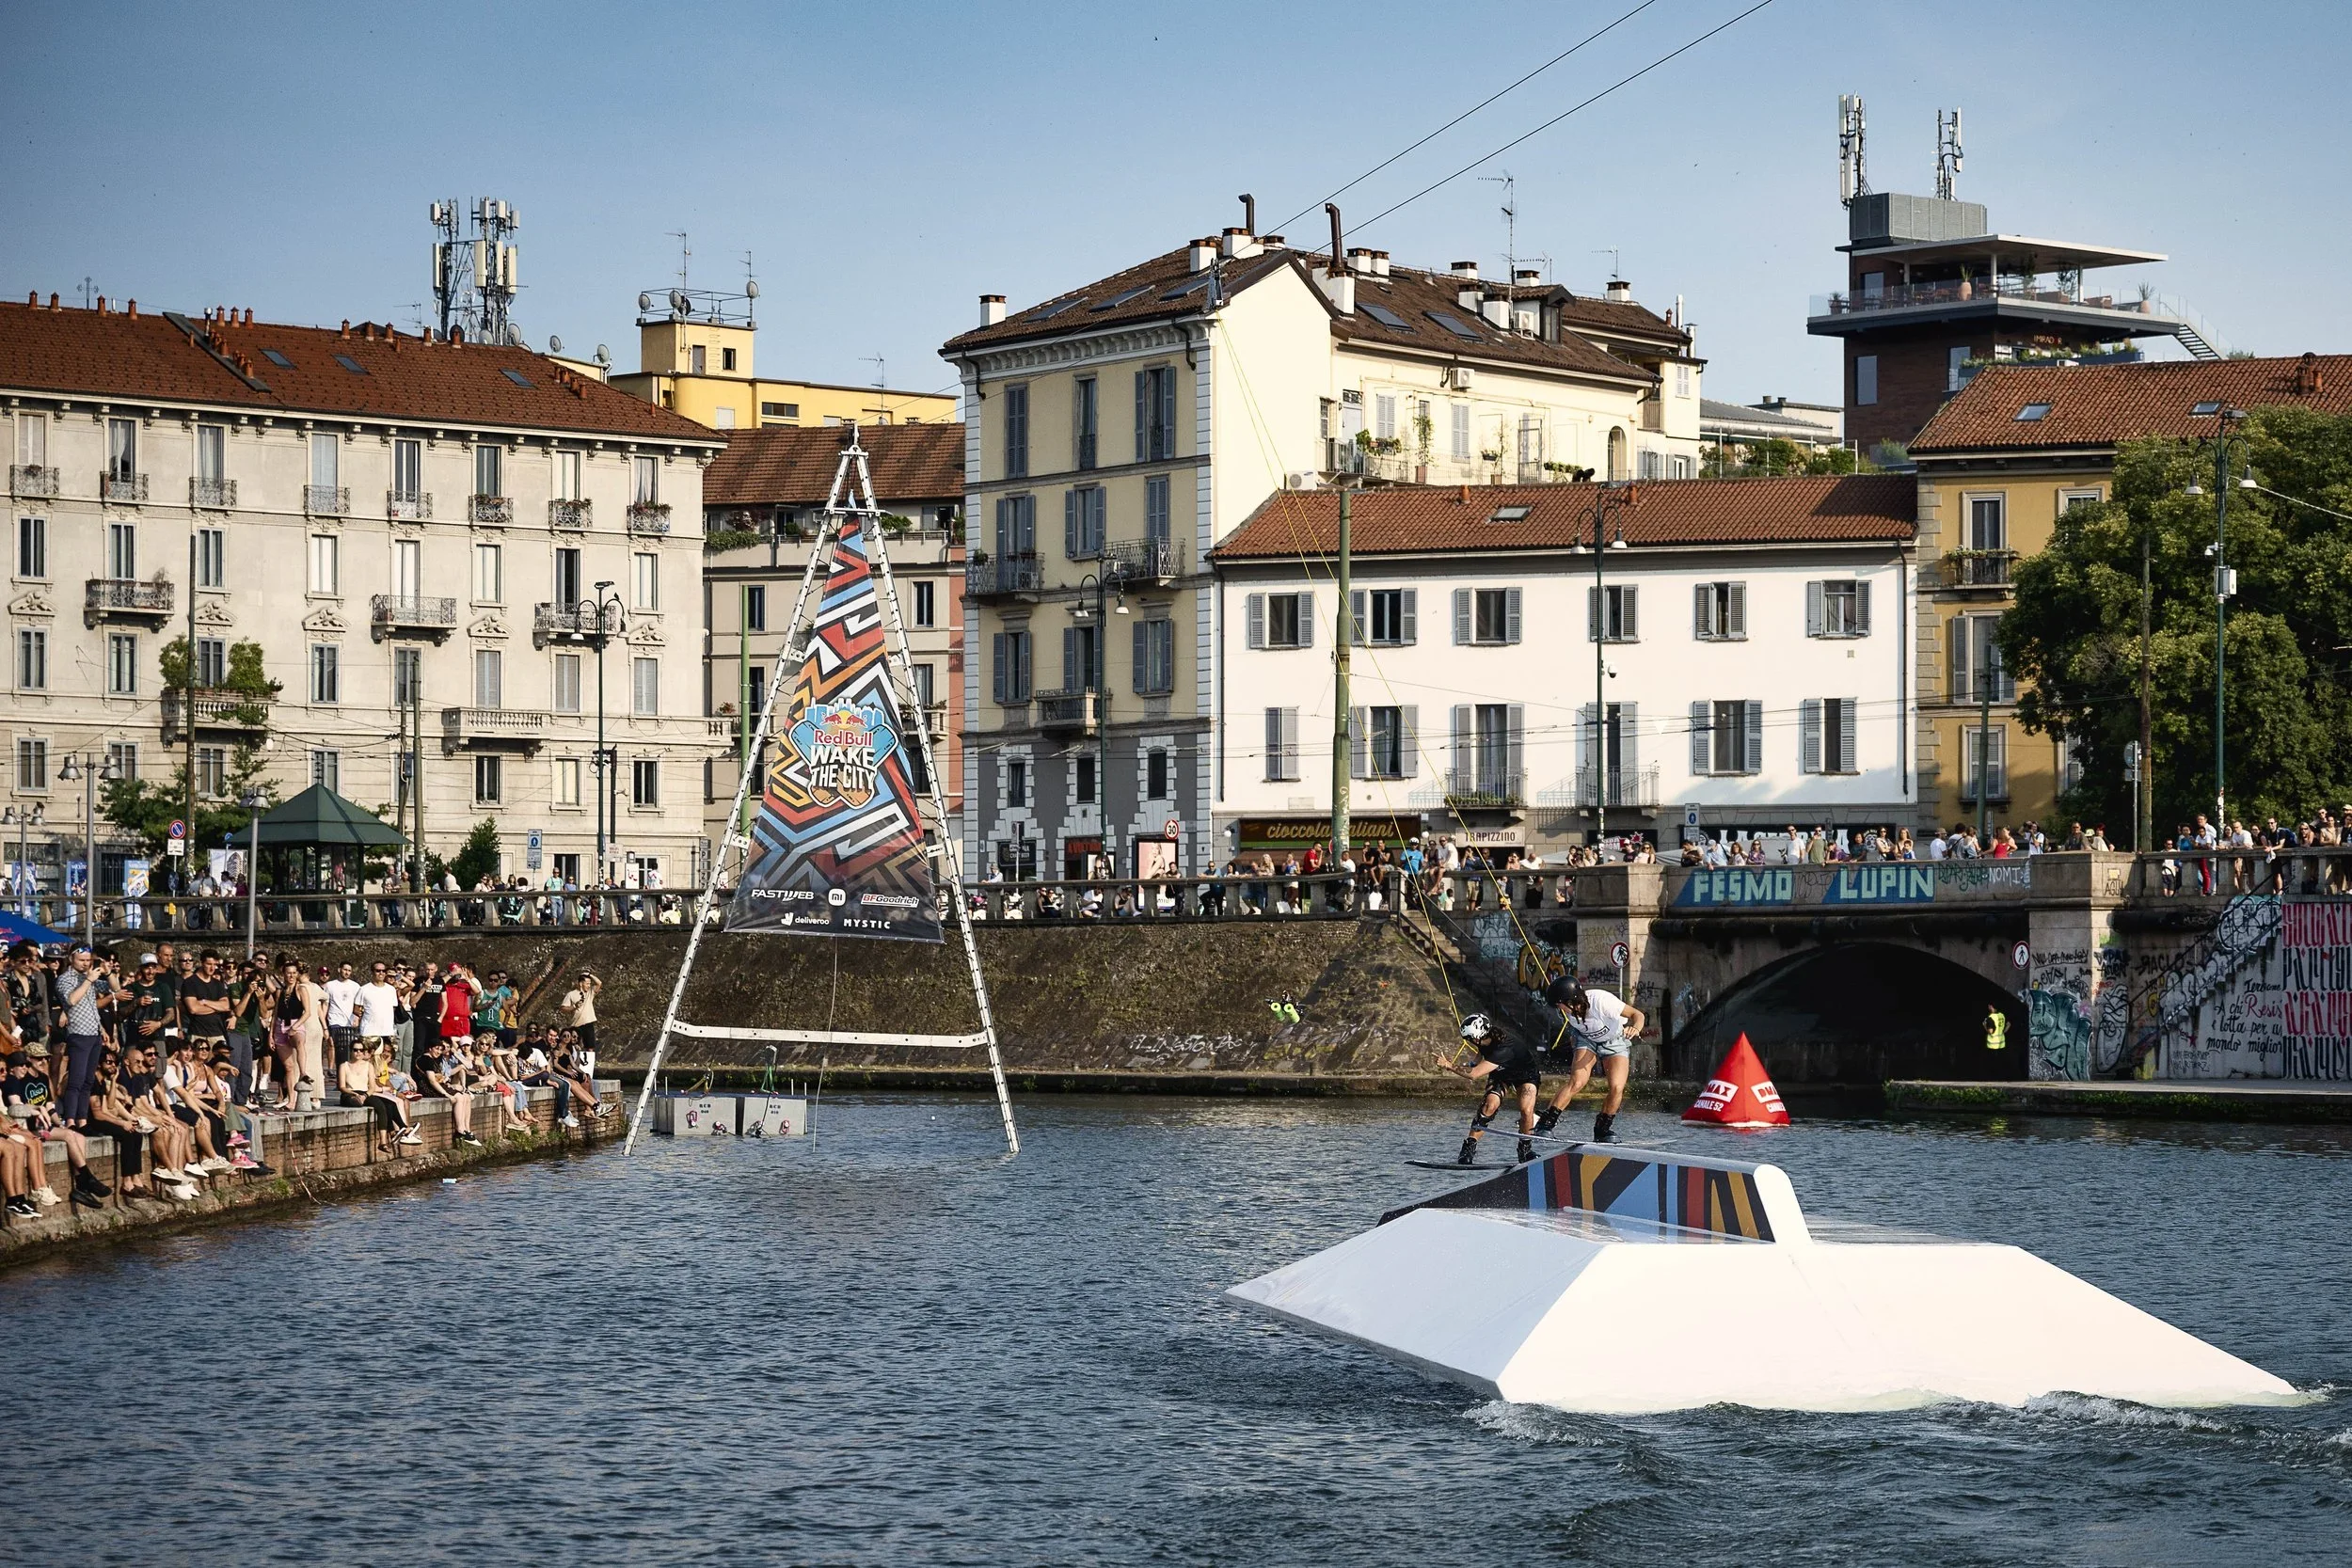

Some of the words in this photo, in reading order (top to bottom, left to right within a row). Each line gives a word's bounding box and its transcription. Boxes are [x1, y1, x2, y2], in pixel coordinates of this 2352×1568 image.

[814, 729, 843, 744] Red
[845, 731, 872, 746] Bull
[810, 745, 876, 768] WAKE
[811, 764, 838, 787] THE
[843, 765, 875, 790] CITY
[1168, 825, 1176, 834] 30
[1266, 821, 1394, 838] cioccolaaliani
[1465, 832, 1516, 842] TRAPIZZINO
[1840, 864, 1934, 900] LUPIN
[751, 889, 815, 902] FASTWEB
[863, 895, 919, 906] BFGoodrich
[795, 916, 830, 925] deliveroo
[843, 918, 891, 929] MYSTIC
[2229, 995, 2244, 1016] chi
[487, 1008, 494, 1022] 1
[2219, 1016, 2246, 1034] lotta
[2249, 1022, 2268, 1037] per
[2206, 1034, 2241, 1052] mondo
[1704, 1083, 1732, 1097] MAX
[1693, 1100, 1714, 1110] CANALE
[1714, 1101, 1724, 1112] 52
